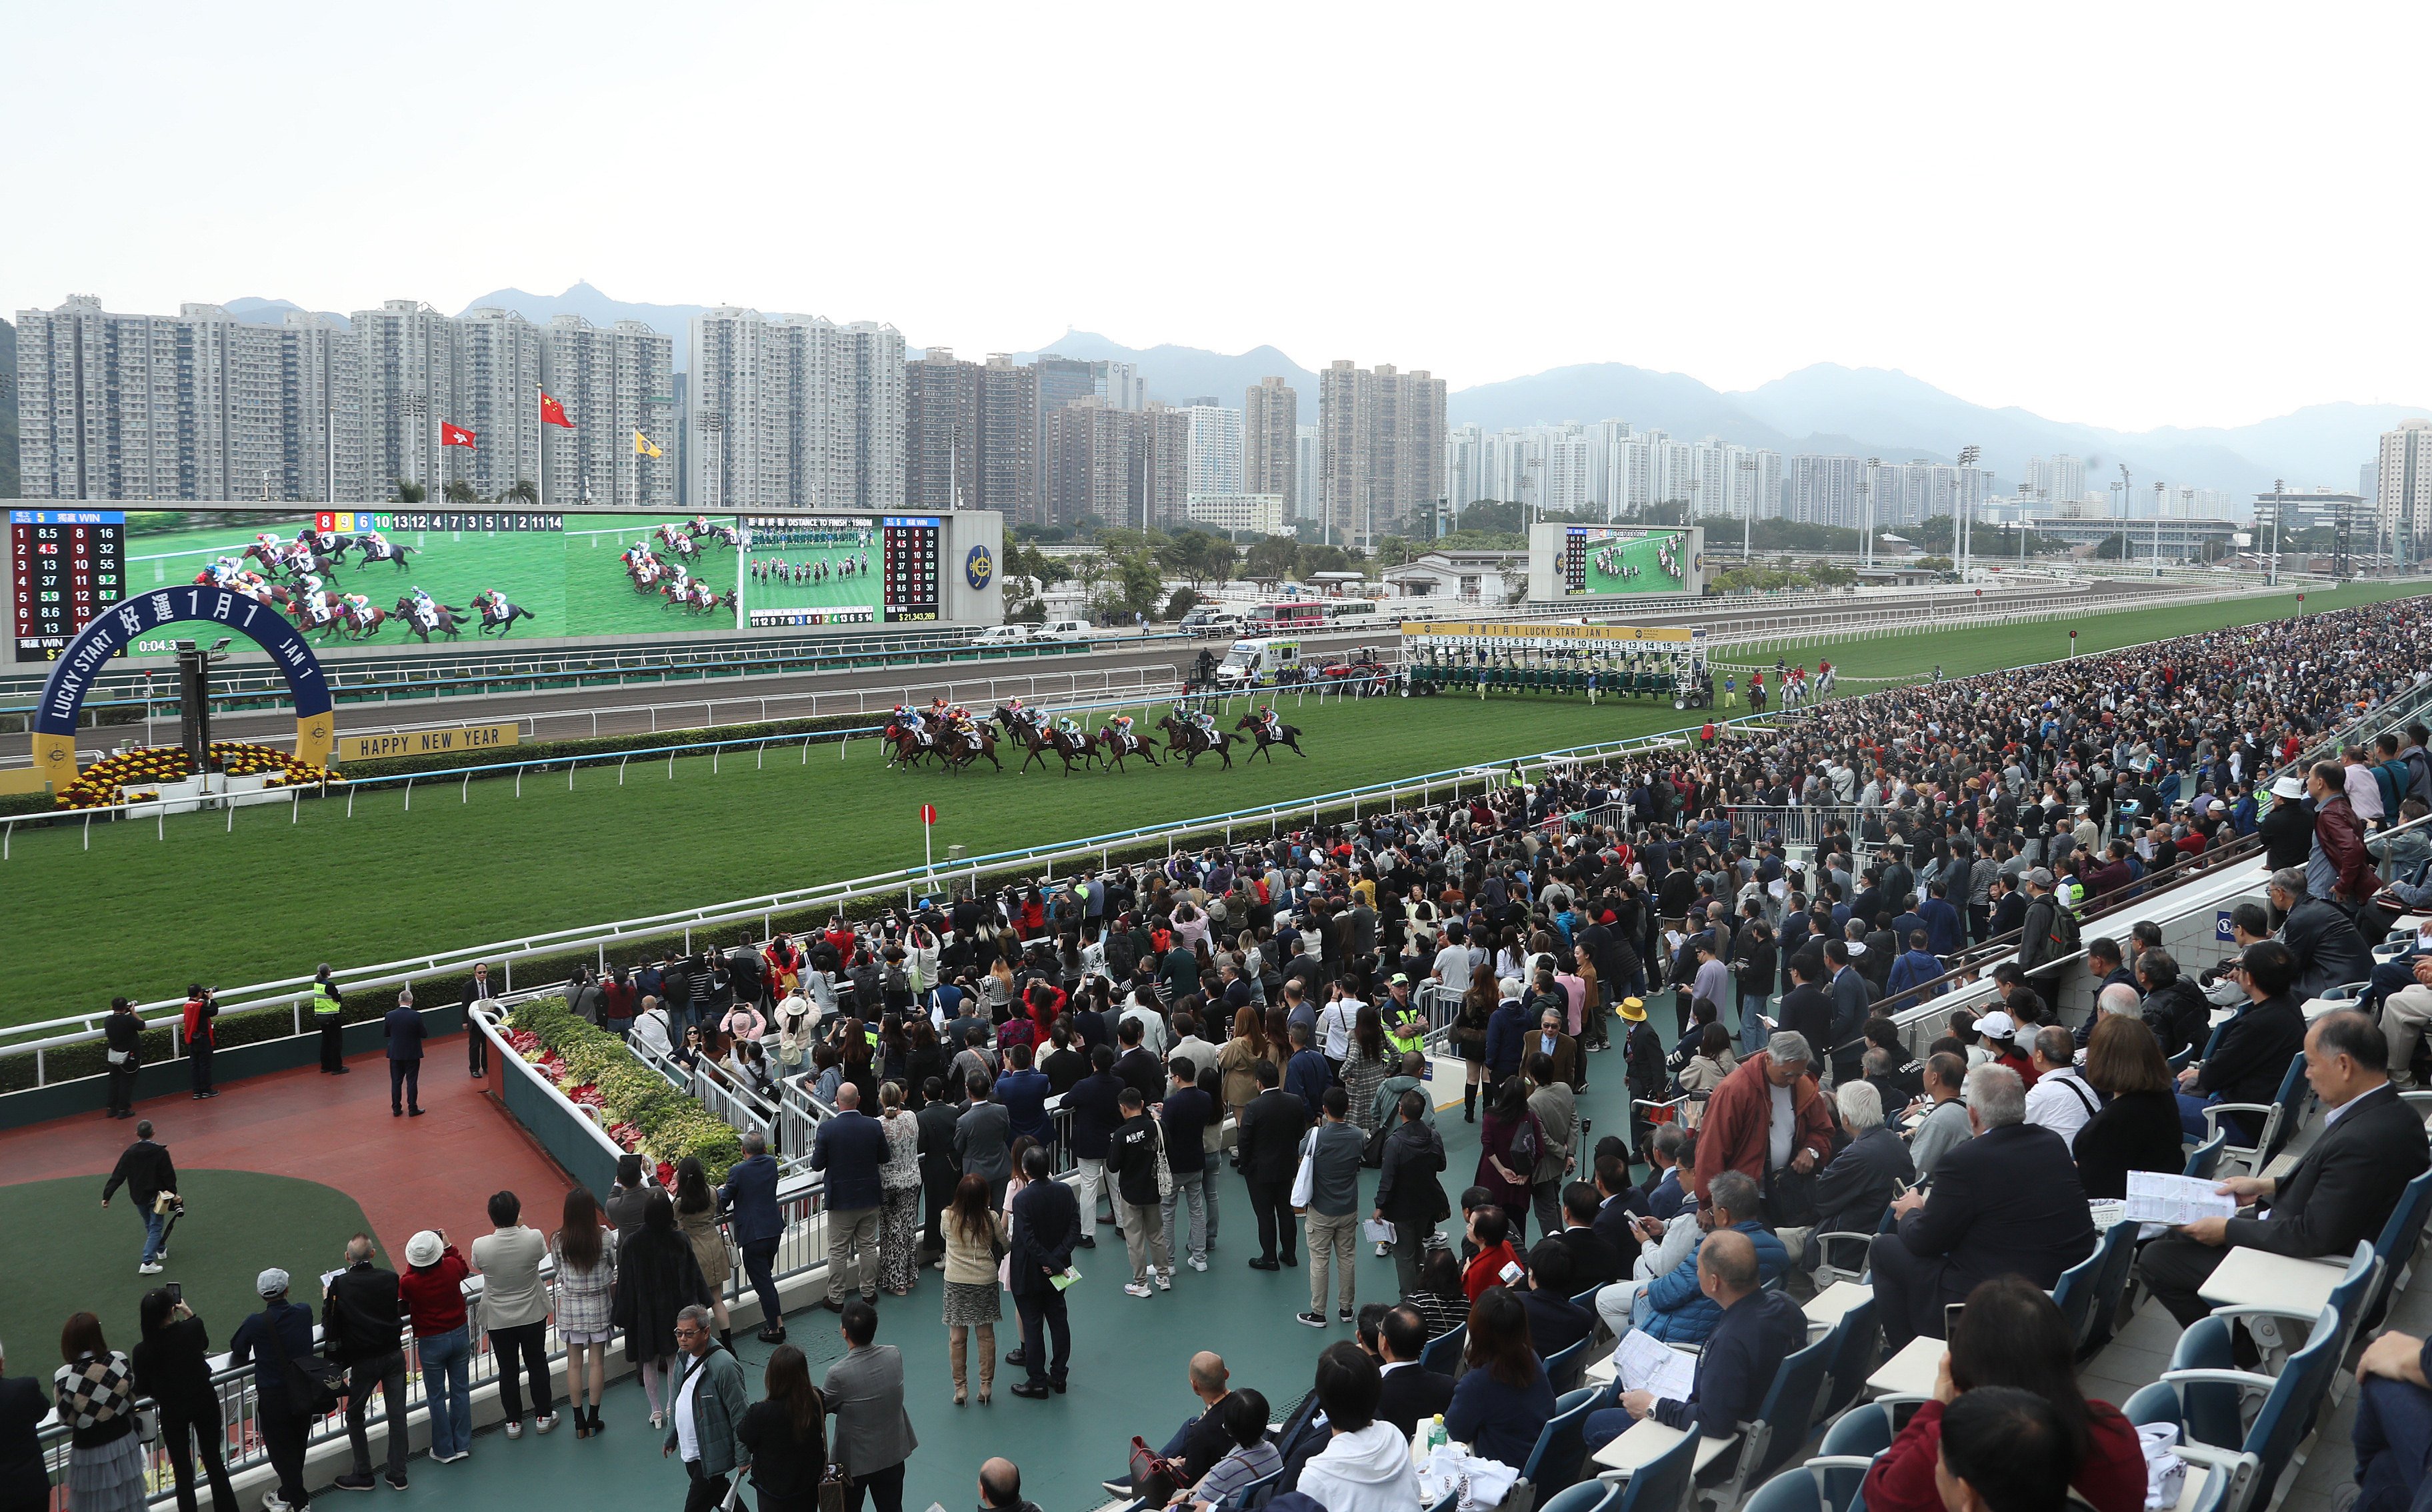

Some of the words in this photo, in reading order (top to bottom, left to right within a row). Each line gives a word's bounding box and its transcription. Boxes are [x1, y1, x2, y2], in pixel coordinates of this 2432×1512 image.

[37, 513, 45, 523] 5
[79, 514, 100, 522] WIN
[321, 517, 329, 527] 8
[341, 517, 349, 527] 9
[360, 517, 368, 527] 6
[374, 517, 390, 527] 10
[393, 517, 408, 527] 13
[411, 517, 426, 527] 12
[433, 517, 441, 527] 4
[451, 517, 459, 527] 7
[469, 517, 476, 527] 3
[486, 517, 493, 527] 5
[503, 517, 509, 527] 1
[519, 517, 527, 527] 2
[533, 517, 545, 527] 11
[549, 517, 562, 527] 14
[852, 519, 872, 527] 1960M
[18, 529, 23, 538] 1
[39, 529, 57, 538] 8.5
[76, 529, 83, 538] 8
[100, 529, 113, 538] 16
[18, 545, 25, 554] 2
[39, 544, 57, 554] 4.5
[77, 544, 84, 553] 9
[100, 544, 113, 553] 32
[19, 561, 25, 570] 3
[43, 560, 56, 570] 13
[75, 560, 88, 569] 10
[101, 559, 114, 569] 55
[19, 577, 26, 586] 4
[42, 576, 57, 586] 37
[75, 575, 86, 585] 11
[99, 575, 116, 585] 9.2
[19, 593, 27, 602] 5
[41, 591, 59, 601] 5.9
[75, 591, 89, 601] 12
[99, 590, 116, 600] 8.7
[20, 608, 27, 618] 6
[41, 607, 59, 617] 8.6
[76, 607, 89, 616] 13
[905, 613, 935, 621] 21,343,269
[751, 617, 759, 626] 11
[760, 617, 768, 625] 12
[771, 617, 775, 625] 9
[780, 617, 785, 625] 7
[787, 617, 795, 625] 10
[798, 616, 802, 624] 3
[825, 615, 829, 623] 2
[21, 624, 27, 633] 7
[45, 623, 58, 633] 13
[1525, 627, 1551, 635] LUCKY
[1556, 628, 1580, 637] START
[1585, 628, 1601, 637] JAN
[42, 639, 63, 647] WIN
[51, 669, 83, 719] LUCKY
[74, 629, 113, 672] START
[279, 638, 306, 666] JAN
[299, 668, 313, 679] 1
[361, 736, 409, 756] HAPPY
[422, 732, 452, 750] NEW
[464, 729, 499, 746] YEAR
